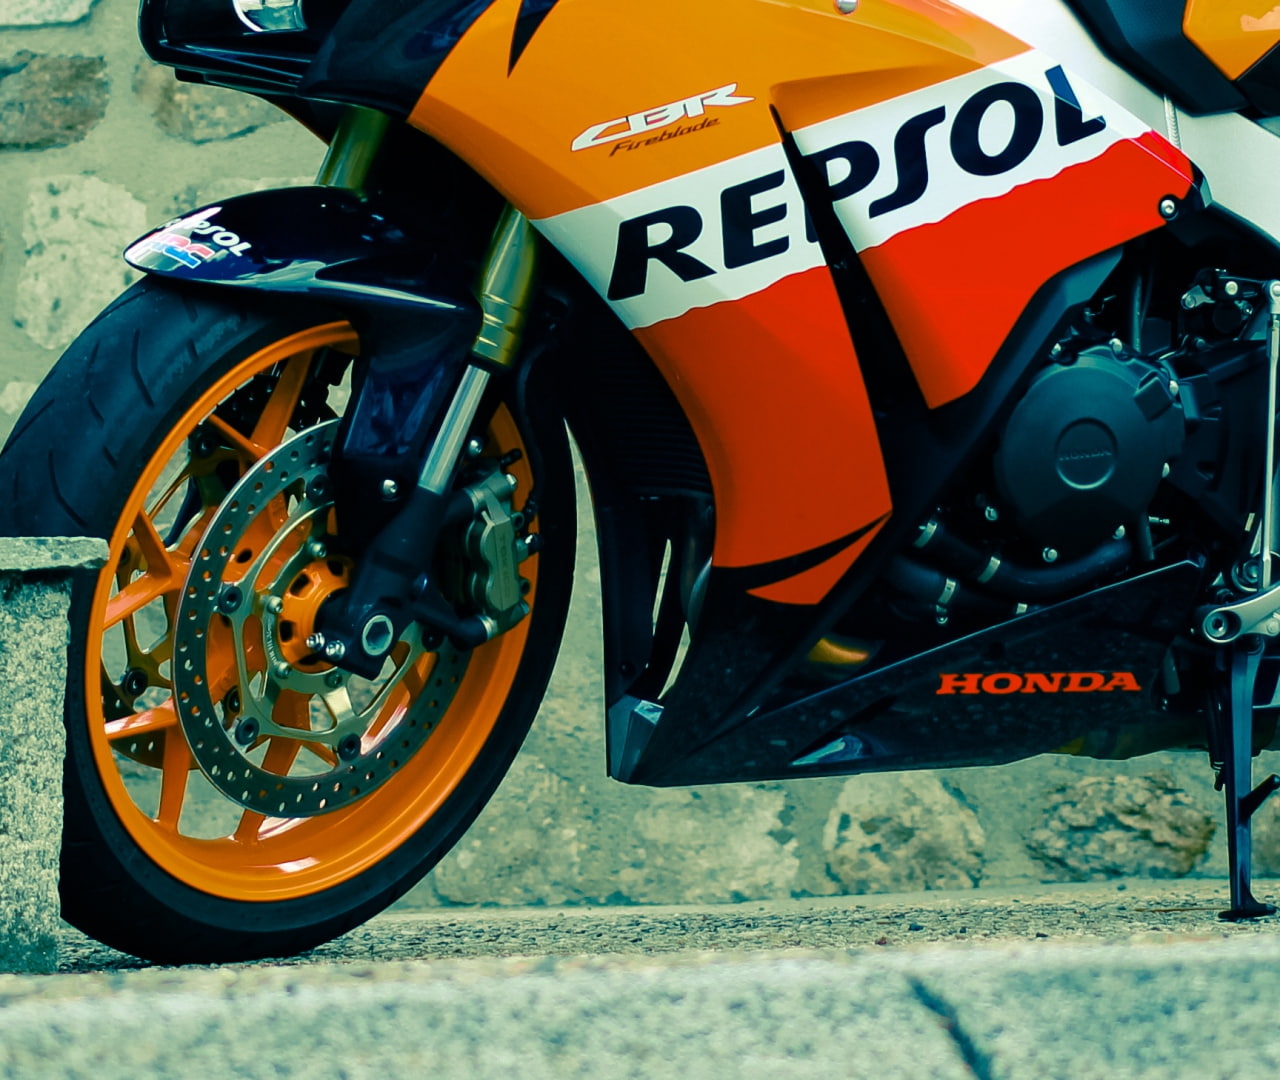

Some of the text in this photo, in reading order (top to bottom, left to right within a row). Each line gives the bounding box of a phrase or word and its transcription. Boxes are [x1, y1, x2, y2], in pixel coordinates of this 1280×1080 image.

[571, 82, 756, 151] CBR
[609, 117, 721, 158] Fireblade
[606, 64, 1107, 302] REPSOL
[935, 671, 1143, 695] HONDA
